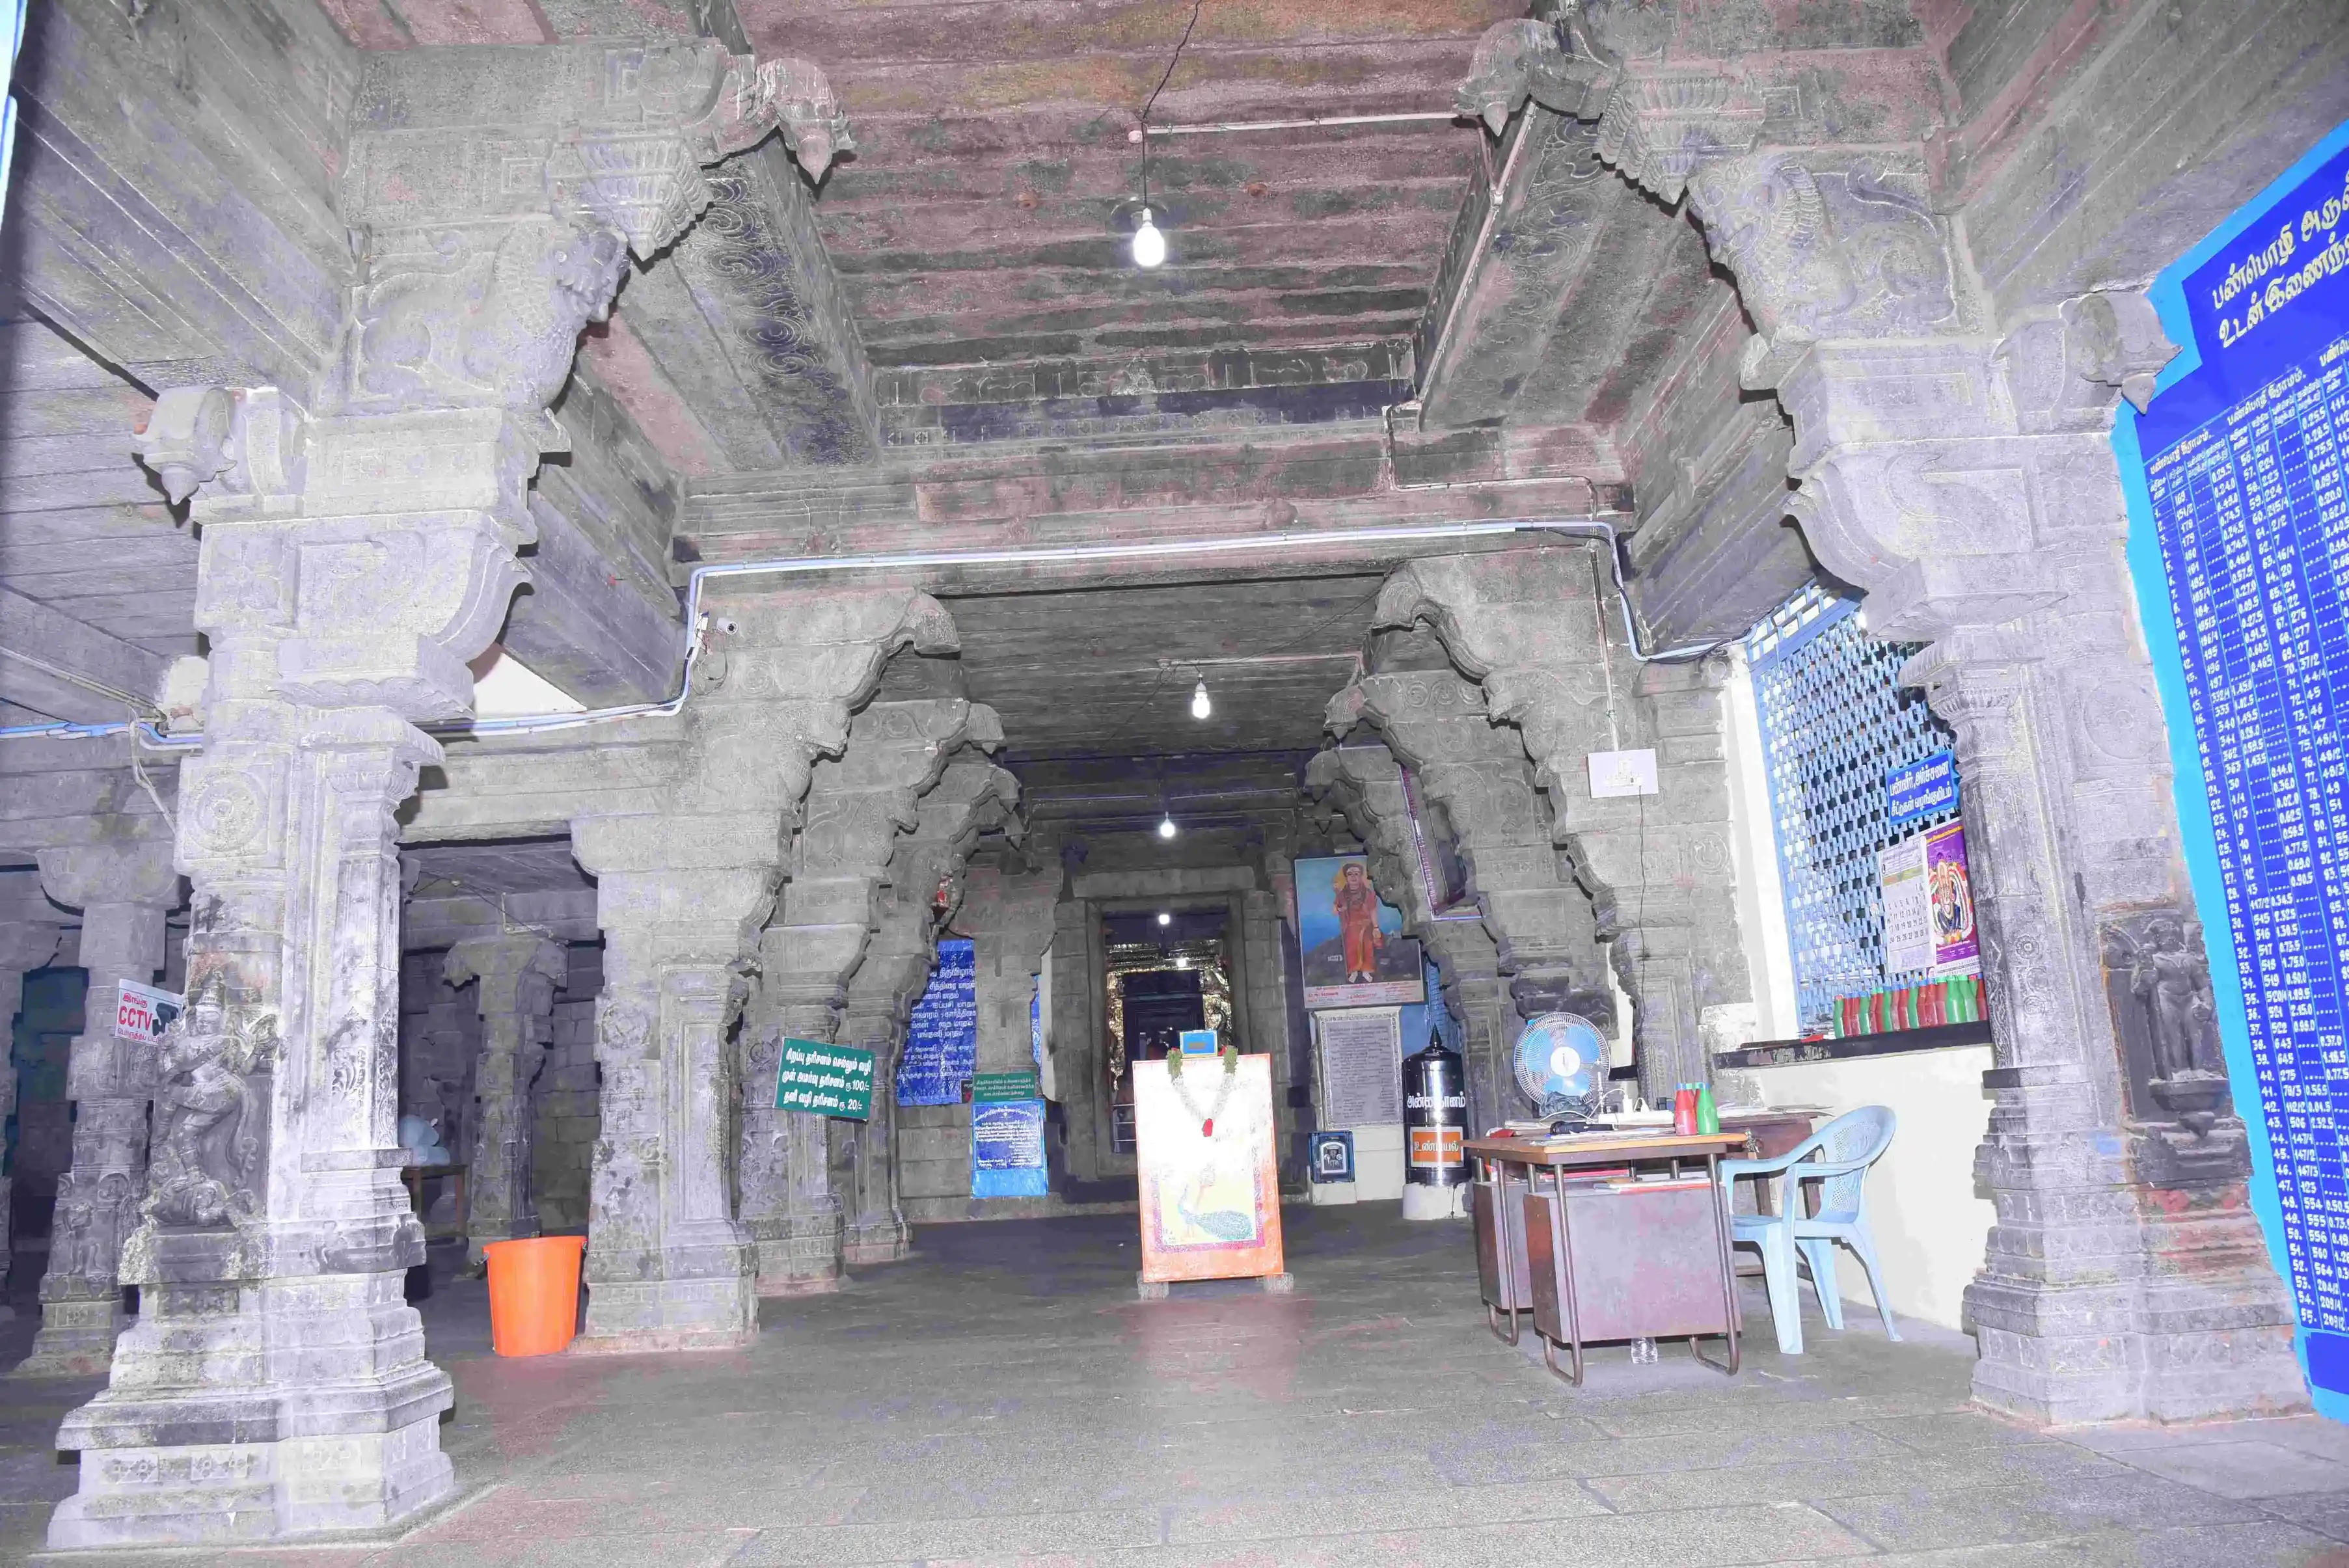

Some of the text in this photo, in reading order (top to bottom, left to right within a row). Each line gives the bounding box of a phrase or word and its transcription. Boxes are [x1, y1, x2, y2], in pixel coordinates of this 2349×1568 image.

[2266, 563, 2292, 584] 64. 20
[2270, 580, 2296, 600] 65. 21
[2273, 593, 2300, 615] 66. 22
[2276, 607, 2307, 630] 67. 276
[2279, 622, 2310, 645] 68. 277
[2282, 640, 2309, 662] 69. 27
[2184, 658, 2193, 669] 12.
[2283, 653, 2320, 676] 70. 37/2
[2186, 672, 2197, 683] 13.
[2287, 678, 2300, 690] 71.
[2190, 687, 2201, 697] 14.
[2290, 686, 2320, 706] 72. 45
[2192, 699, 2203, 711] 15.
[2293, 703, 2322, 722] 73. 46
[2195, 713, 2206, 725] 16.
[2229, 903, 2242, 914] 29.
[2250, 897, 2270, 910] 117/2
[2231, 912, 2270, 929] 30. 515
[2234, 932, 2246, 943] 31.
[2255, 928, 2270, 941] 516
[2237, 947, 2251, 959] 32.
[2259, 943, 2272, 956] 517
[2239, 962, 2252, 974] 33.
[2241, 973, 2279, 990] 34. 519
[2244, 993, 2259, 1005] 35.
[118, 1006, 153, 1031] CCTV
[2247, 1008, 2261, 1020] 36.
[2269, 1005, 2283, 1018] 521
[2249, 1023, 2262, 1036] 37.
[2253, 1039, 2266, 1050] 38.
[2275, 1038, 2292, 1049] 643
[806, 1050, 832, 1066] தரிசனம்
[858, 1059, 872, 1076] வழி
[2256, 1053, 2294, 1065] 39. 645
[782, 1068, 796, 1083] முன்
[819, 1072, 845, 1088] தரிசனம்
[2260, 1070, 2275, 1081] 40.
[2280, 1069, 2296, 1081] 275
[783, 1088, 798, 1104] தனி
[798, 1090, 813, 1108] வழி
[812, 1092, 839, 1108] தரிசனம்
[2262, 1087, 2277, 1097] 41.
[2264, 1101, 2280, 1113] 42.
[2286, 1102, 2306, 1113] 112/2
[2268, 1116, 2283, 1128] 43.
[2290, 1116, 2305, 1128] 506
[2271, 1133, 2288, 1144] 44.
[2274, 1148, 2315, 1161] 45. 147/2
[2276, 1164, 2318, 1177] 46. 147/3
[2279, 1180, 2316, 1193] 47. 123
[2282, 1196, 2323, 1210] 48. 554
[2285, 1213, 2326, 1227] 49. 555
[2287, 1227, 2328, 1243] 50. 556
[2290, 1243, 2328, 1259] 51. 560
[2293, 1259, 2333, 1277] 52. 564
[2295, 1275, 2311, 1289] 53.
[2298, 1290, 2315, 1305] 54.
[2301, 1308, 2316, 1324] 55.
